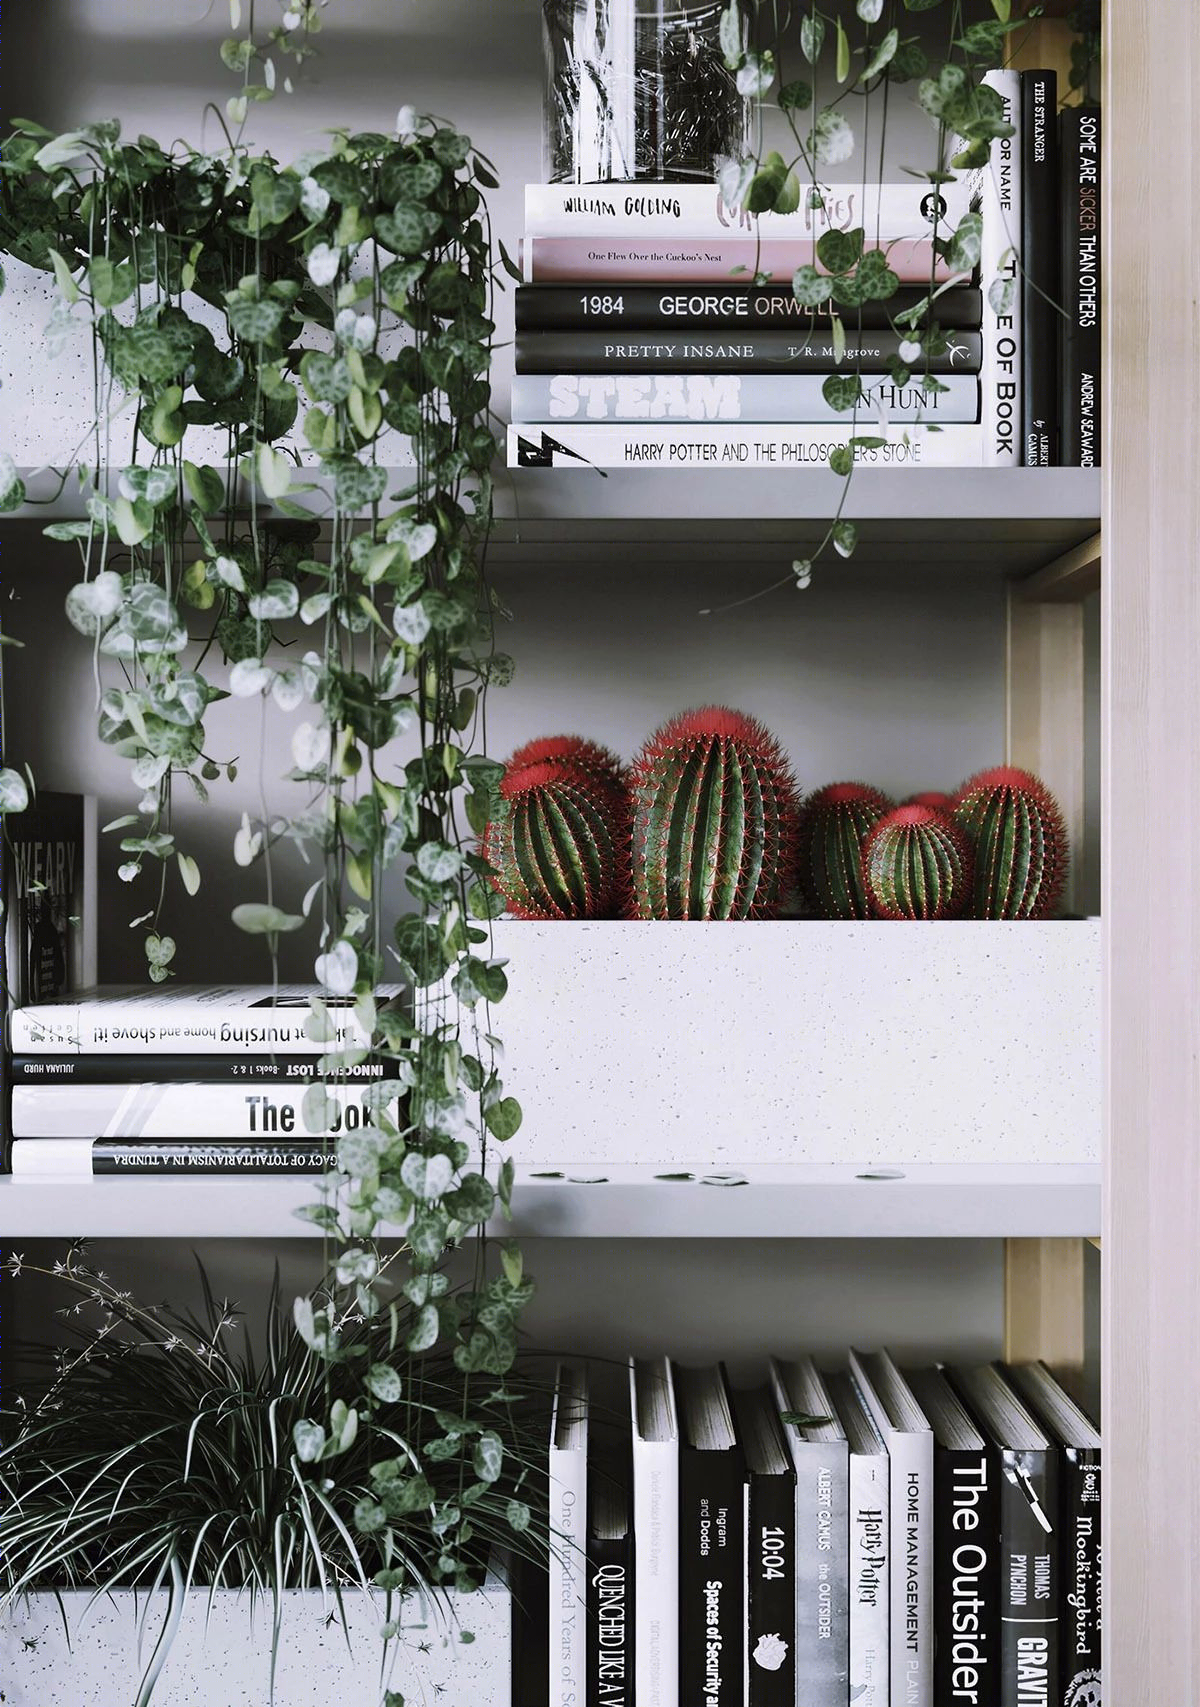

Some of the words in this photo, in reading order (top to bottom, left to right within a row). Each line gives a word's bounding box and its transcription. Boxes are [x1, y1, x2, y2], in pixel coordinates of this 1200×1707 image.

[1035, 81, 1045, 103] THE
[1001, 96, 1012, 160] AUTOR
[1035, 107, 1045, 162] STRANGER
[1079, 117, 1097, 153] SOME
[1079, 157, 1097, 183] ARE
[1000, 166, 1011, 211] NAME
[564, 197, 616, 217] WILLIAM
[625, 197, 681, 218] GOLDING
[1079, 188, 1096, 231] SICKER
[588, 251, 606, 261] One
[608, 251, 626, 261] Flew
[629, 252, 648, 261] Over
[651, 252, 663, 261] the
[665, 252, 702, 262] Cuckoo's
[705, 253, 722, 262] Nest
[1079, 235, 1096, 272] THAN
[580, 296, 625, 315] 1984
[659, 296, 749, 316] GEORGE
[1079, 276, 1096, 327] OTHERS
[604, 345, 676, 358] PRETTY
[683, 345, 755, 358] INSANE
[996, 338, 1017, 374] OF
[549, 375, 742, 420] STEAM
[1081, 372, 1094, 414] ANDREW
[996, 382, 1016, 455] BOOK
[625, 444, 665, 460] HARRY
[669, 444, 718, 460] POTTER
[722, 444, 749, 460] AND
[754, 444, 777, 460] THE
[781, 443, 878, 461] PHILOSOERS
[883, 444, 921, 461] STONE
[1027, 433, 1038, 466] CAMUS
[1080, 419, 1094, 468] SEAWARD
[14, 842, 76, 898] WEARY
[94, 1027, 108, 1043] it!
[113, 1026, 156, 1044] shove
[160, 1027, 181, 1040] and
[183, 1026, 216, 1042] home
[221, 1022, 290, 1047] nursing
[24, 1063, 44, 1074] HURD
[46, 1063, 75, 1073] JULIANA
[286, 1065, 314, 1076] LOST
[245, 1096, 295, 1132] The
[114, 1155, 160, 1166] TUNDRA
[162, 1155, 169, 1166] A
[171, 1155, 186, 1166] IN
[188, 1155, 288, 1166] TOTALITARIANISM
[290, 1155, 305, 1166] OF
[308, 1155, 338, 1166] GACY
[817, 1466, 831, 1507] ALBERT
[907, 1472, 919, 1522] HOME
[953, 1458, 988, 1531] The
[561, 1491, 577, 1527] One
[700, 1499, 709, 1517] and
[700, 1520, 711, 1556] Dodds
[716, 1508, 728, 1547] Ingram
[817, 1511, 831, 1551] CAMUS
[857, 1508, 883, 1554] Harry
[561, 1533, 577, 1609] Hundred
[761, 1526, 785, 1580] 10:04
[817, 1563, 830, 1580] the
[856, 1556, 886, 1606] Potter
[906, 1527, 919, 1652] MANAGEMENT
[1010, 1553, 1027, 1606] PYNCHON
[1034, 1554, 1051, 1600] THOMAS
[1066, 1516, 1092, 1655] Mockingbird
[592, 1564, 625, 1647] QUENCHED
[702, 1581, 722, 1618] Spaces
[818, 1585, 831, 1640] OUTSIDER
[561, 1614, 576, 1660] Years
[706, 1621, 722, 1640] of
[952, 1544, 988, 1704] Outsider
[561, 1666, 576, 1686] of
[598, 1650, 625, 1679] LIKE
[702, 1641, 722, 1694] Security
[906, 1660, 919, 1704] PLAIN
[598, 1682, 625, 1695] A
